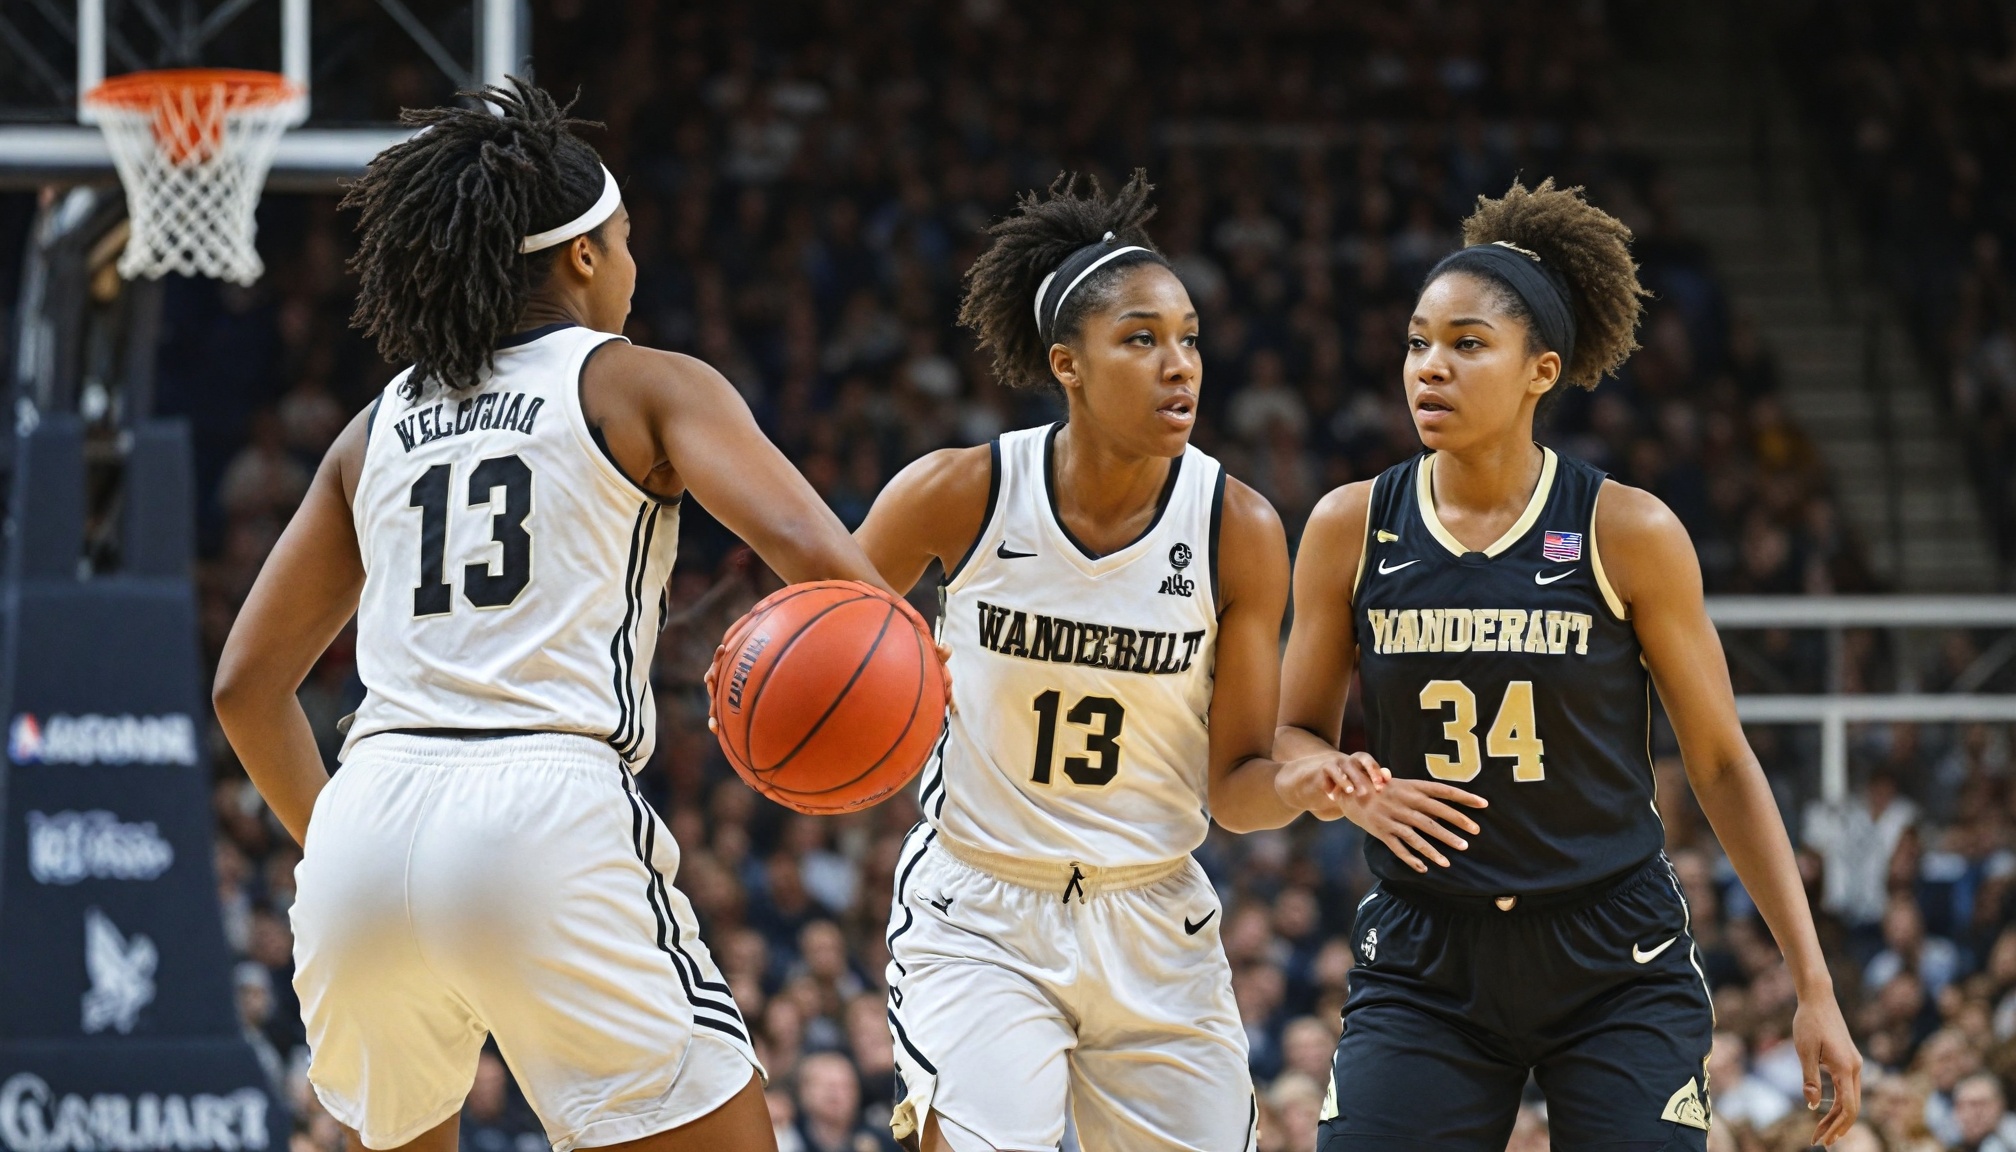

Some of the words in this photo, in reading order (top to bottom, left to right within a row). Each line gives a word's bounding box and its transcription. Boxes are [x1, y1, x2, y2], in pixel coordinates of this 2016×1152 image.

[409, 454, 535, 620] 13
[1030, 687, 1126, 787] 13
[1419, 679, 1545, 783] 34
